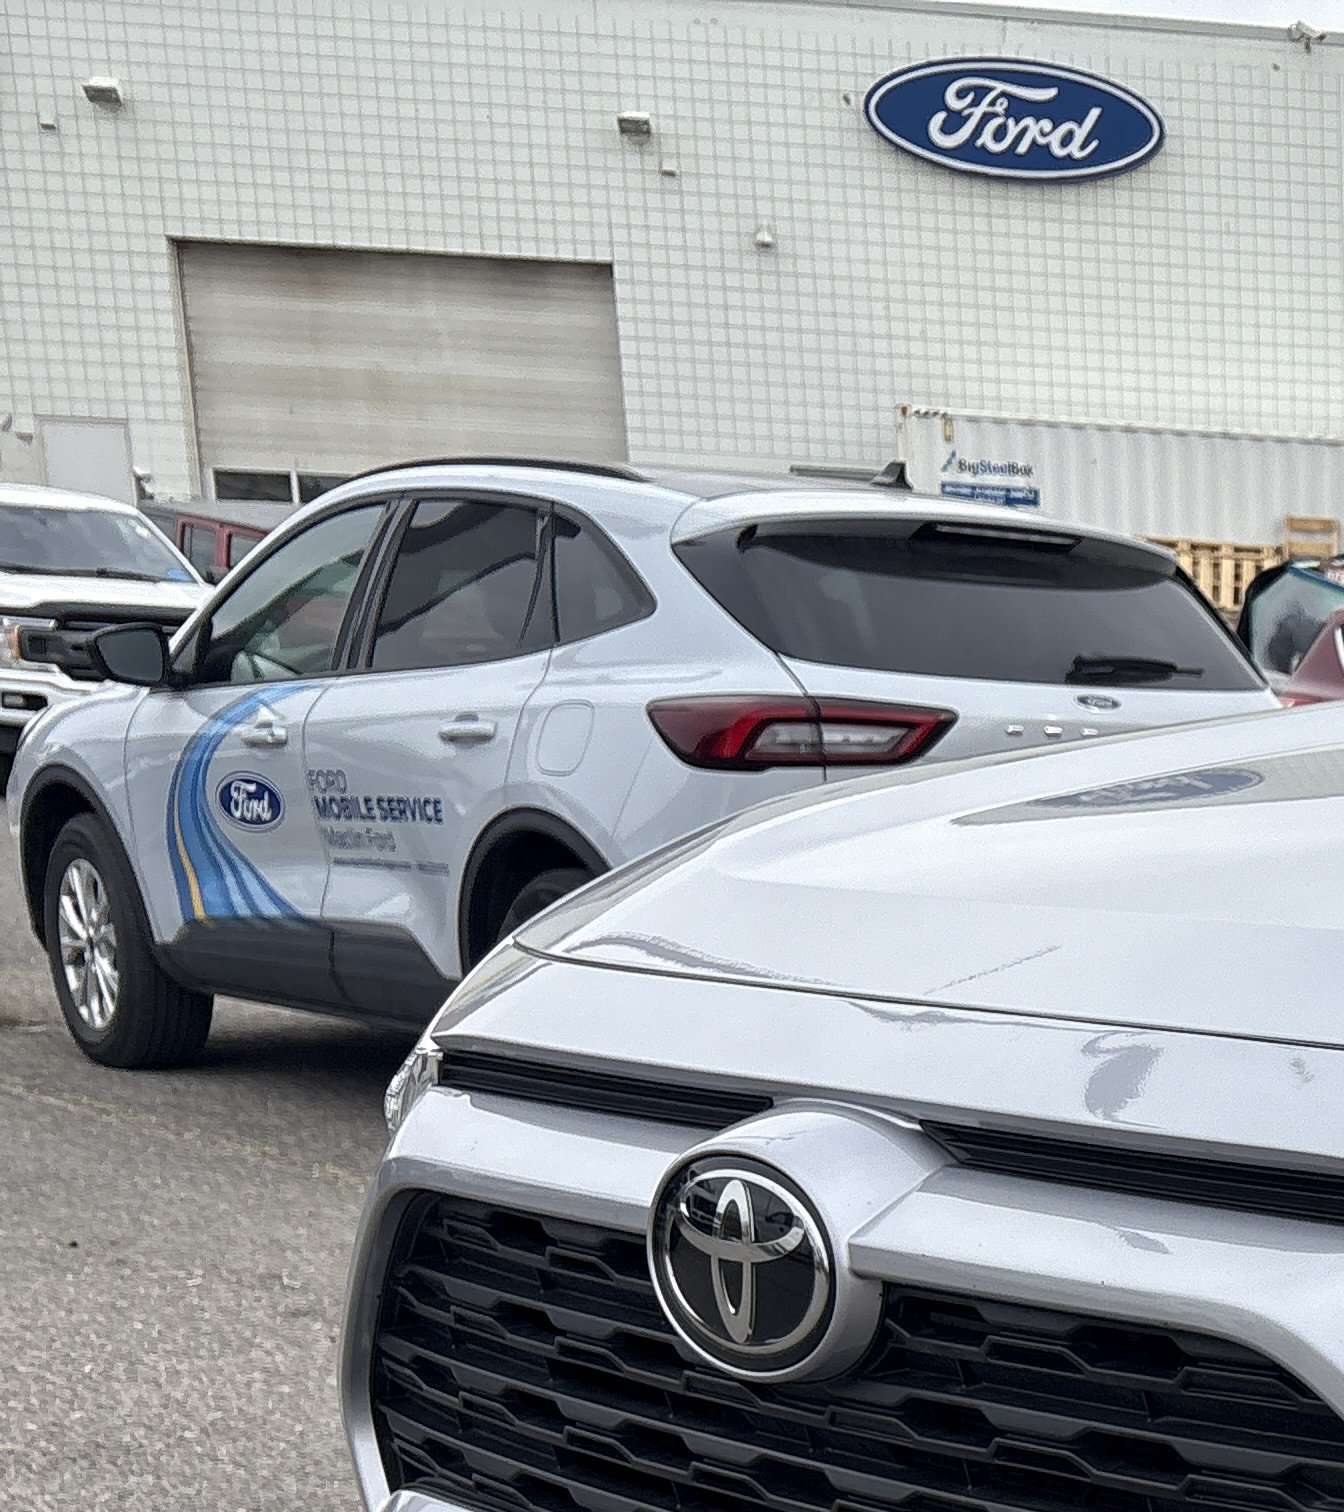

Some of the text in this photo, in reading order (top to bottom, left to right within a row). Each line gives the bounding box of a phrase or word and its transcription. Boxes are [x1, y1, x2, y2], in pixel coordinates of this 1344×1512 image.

[927, 76, 1102, 160] Ford
[957, 457, 1034, 478] BigSteelBox
[306, 769, 348, 794] FORD
[229, 779, 274, 823] Ford
[313, 794, 444, 824] MOBILE SERVICE
